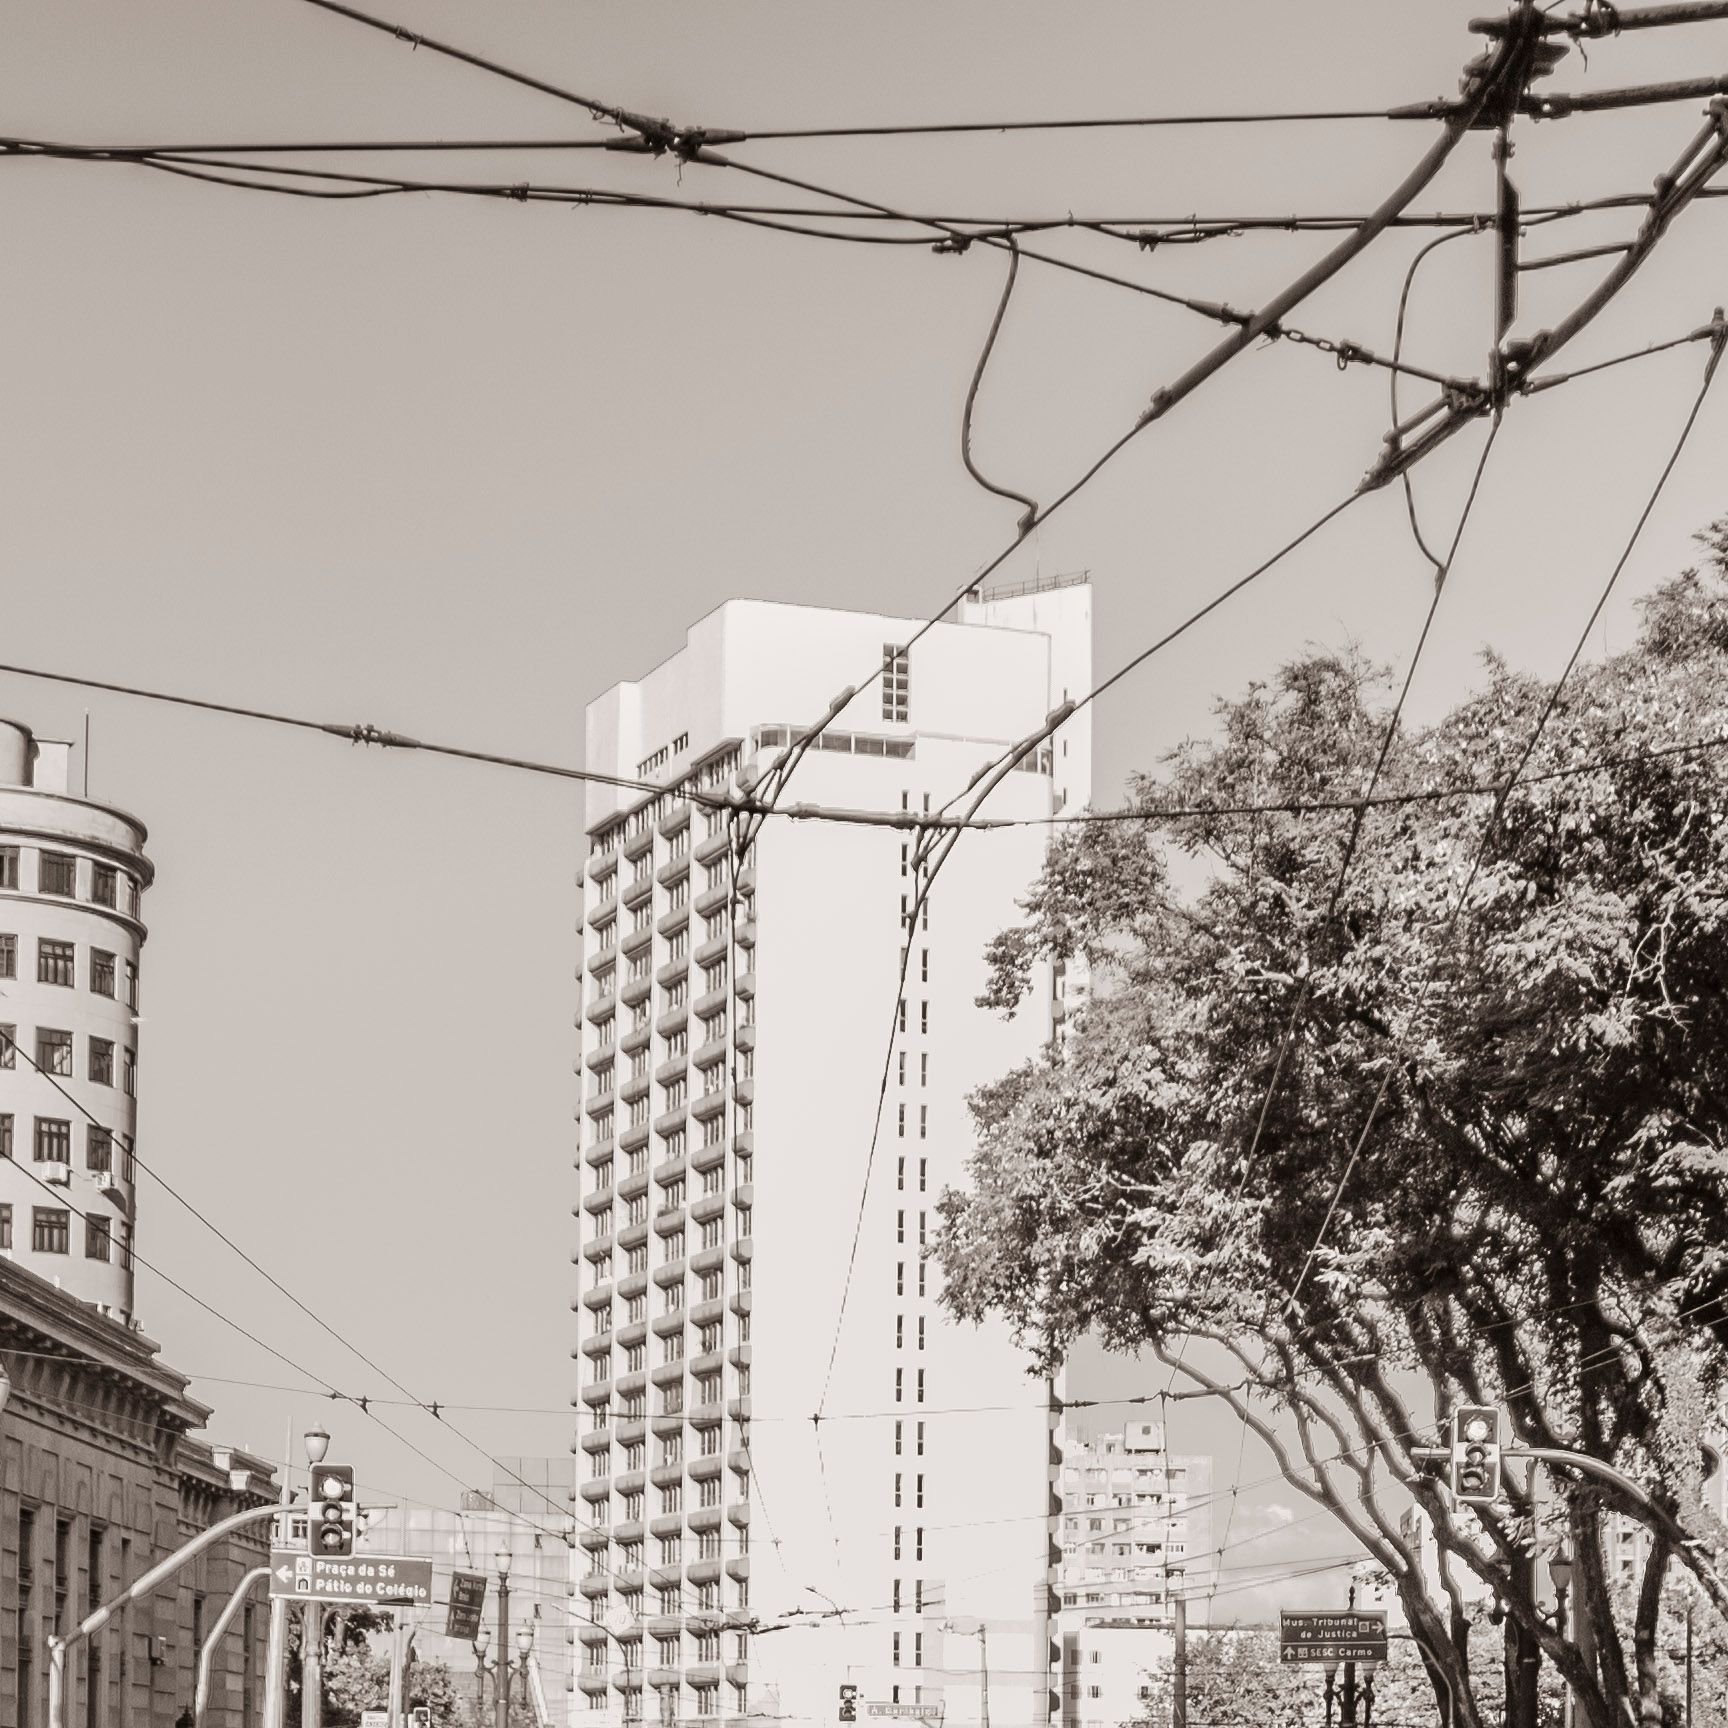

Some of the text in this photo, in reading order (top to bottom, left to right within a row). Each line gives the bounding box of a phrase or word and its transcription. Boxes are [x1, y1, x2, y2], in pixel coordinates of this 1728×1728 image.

[315, 1561, 396, 1578] Praça da Sé
[315, 1579, 427, 1598] Pátio do Colégio
[1282, 1617, 1358, 1627] Mus. Tribunal
[1317, 1629, 1358, 1639] Justiça
[1310, 1647, 1373, 1657] SESC Carmo
